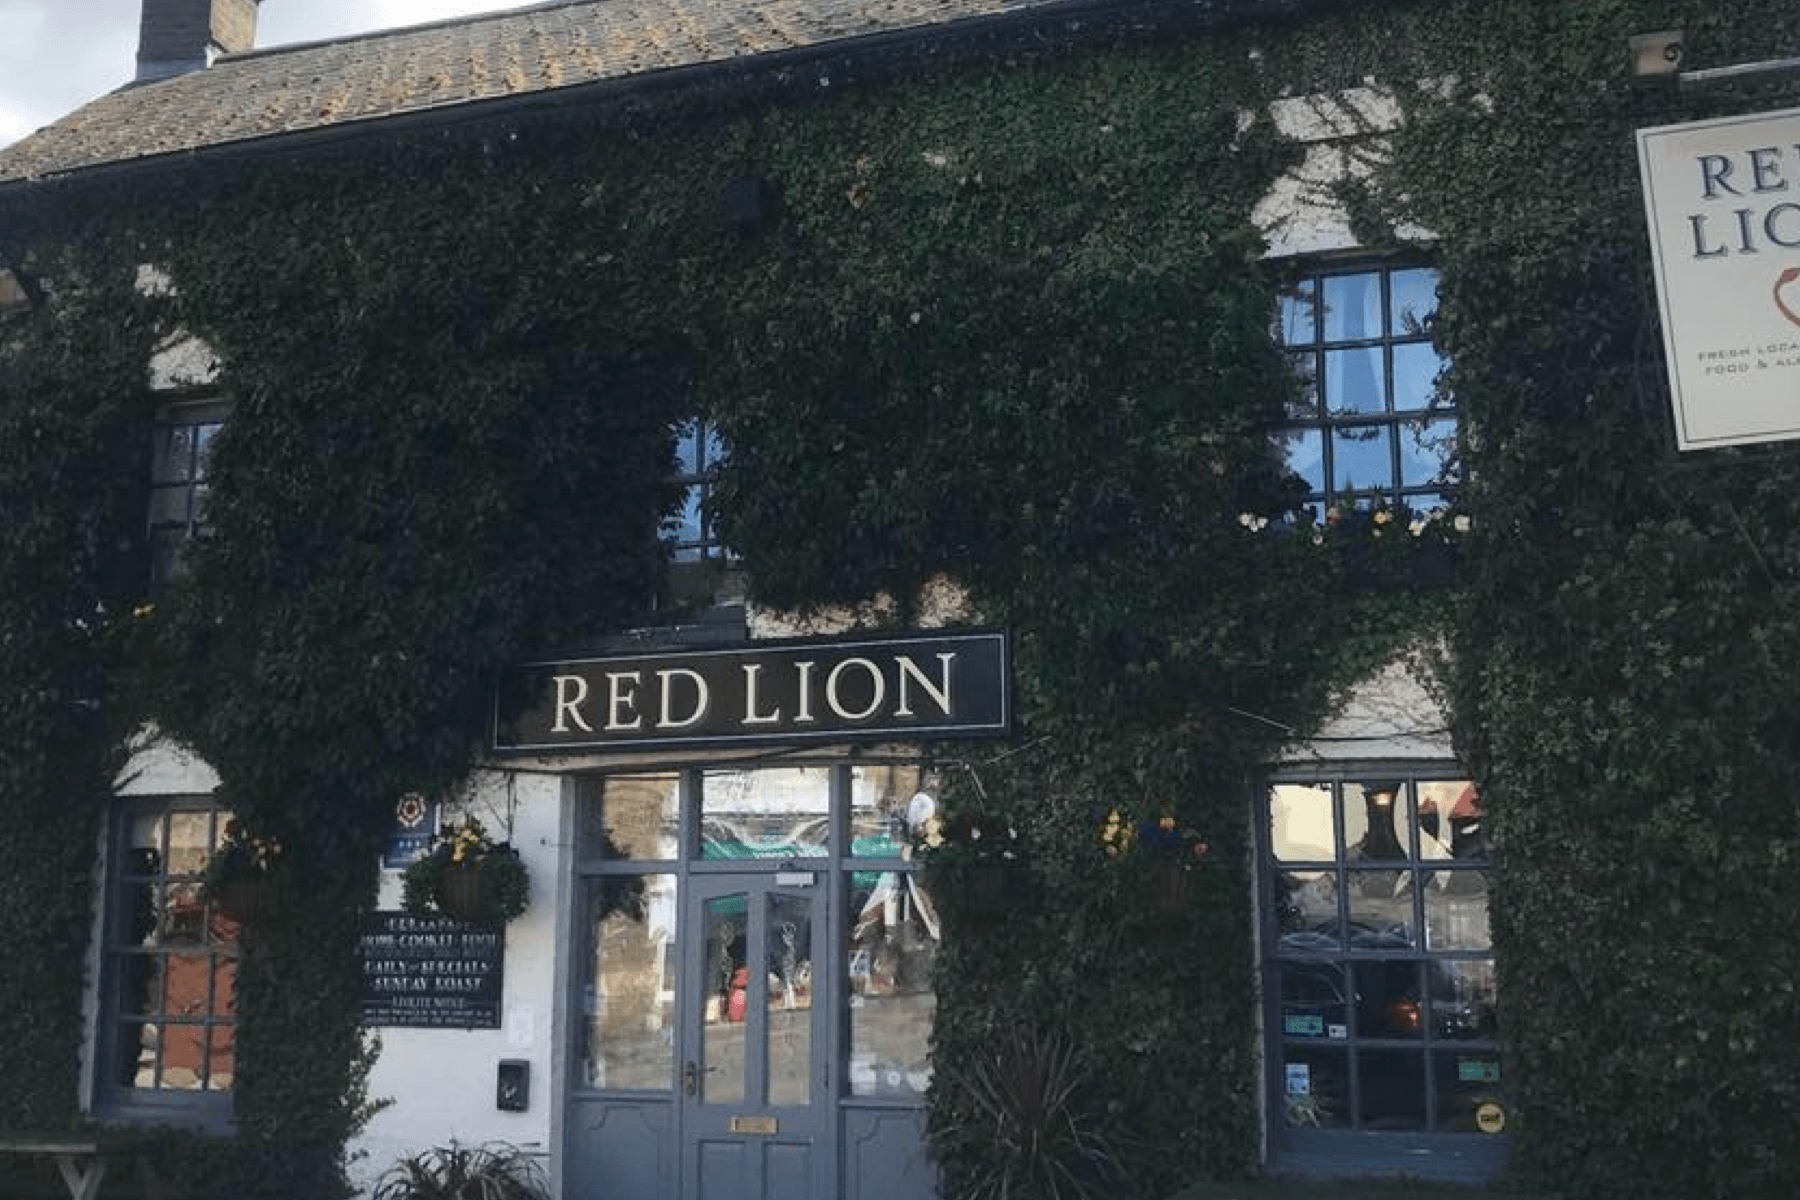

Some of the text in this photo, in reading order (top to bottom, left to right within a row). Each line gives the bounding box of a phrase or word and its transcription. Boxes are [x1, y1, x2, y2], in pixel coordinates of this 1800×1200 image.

[1696, 142, 1800, 200] RE
[1705, 362, 1750, 375] FOOD
[1756, 358, 1768, 369] &
[551, 652, 957, 732] RED LION
